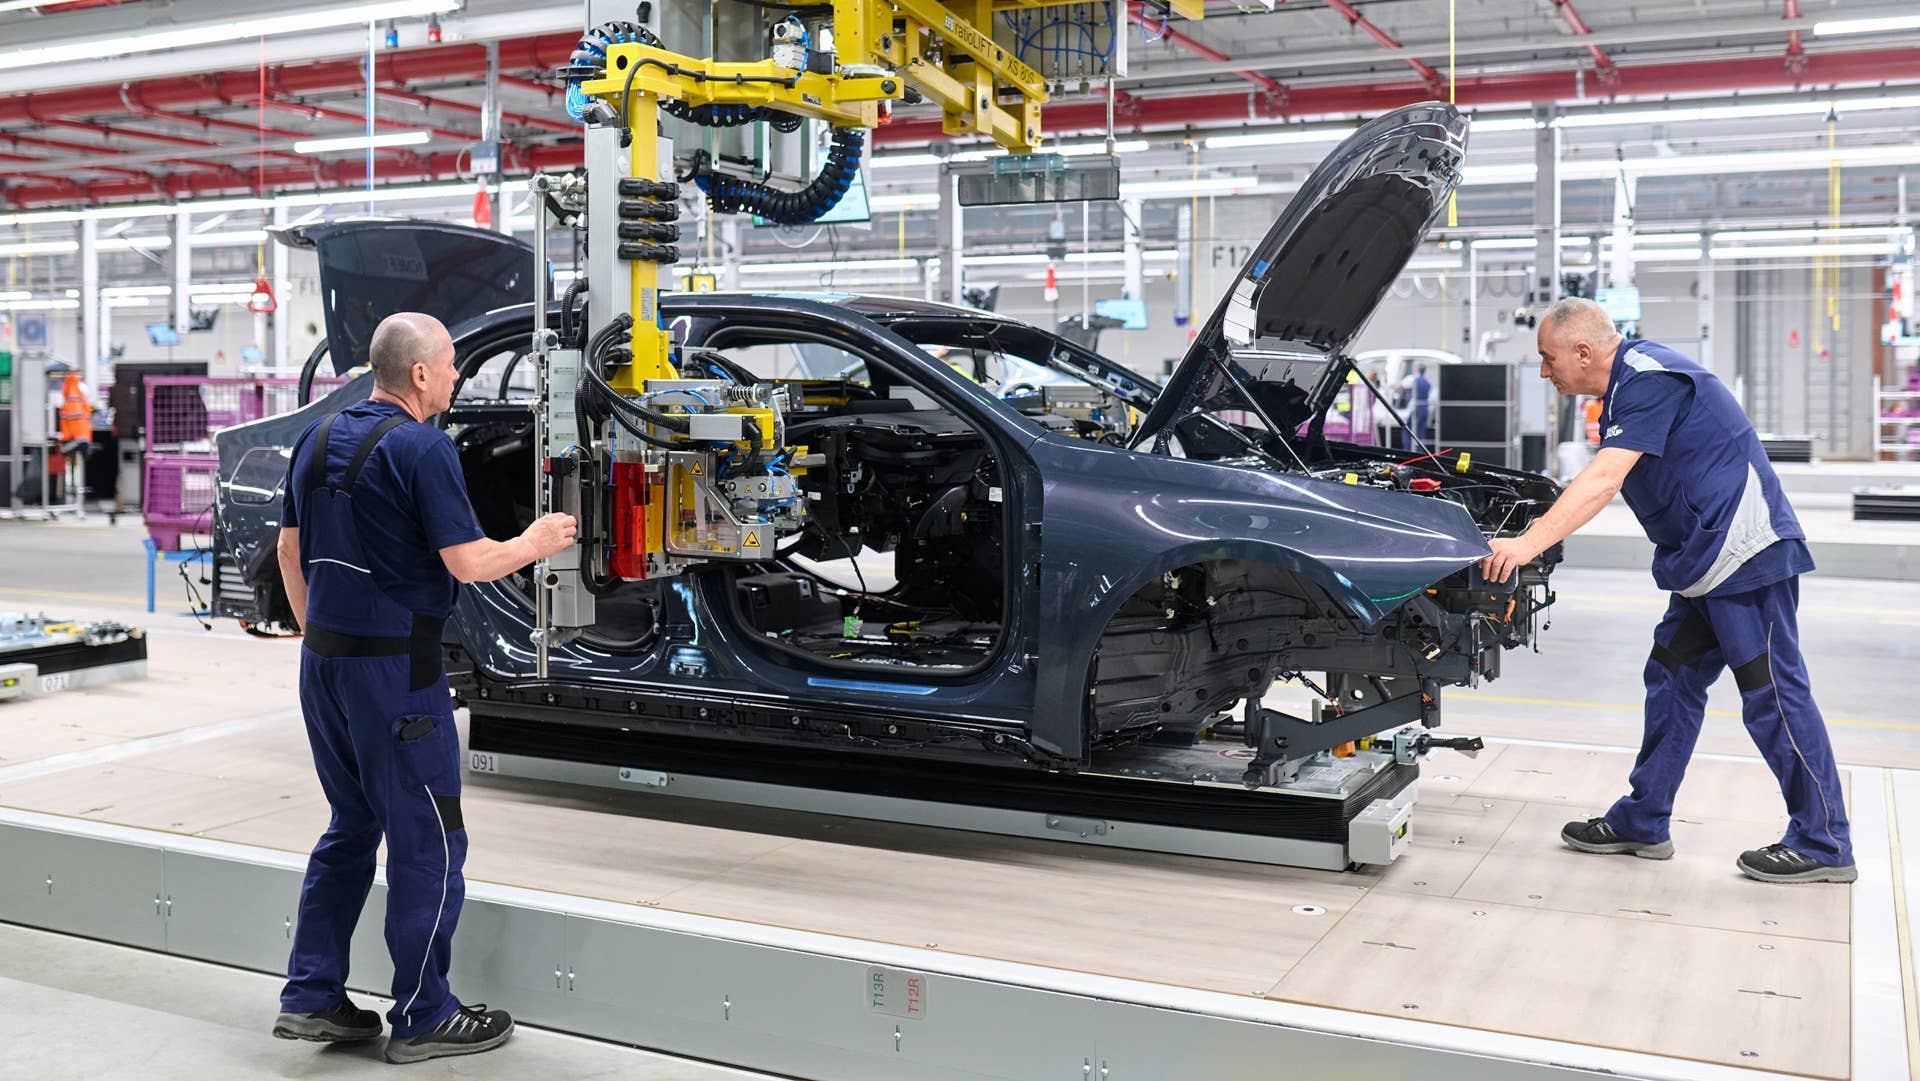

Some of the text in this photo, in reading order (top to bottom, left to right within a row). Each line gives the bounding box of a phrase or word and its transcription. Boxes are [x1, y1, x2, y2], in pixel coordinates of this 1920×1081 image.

[954, 23, 992, 57] ratioLIFT
[1007, 57, 1019, 76] XS
[472, 753, 495, 771] 091
[873, 972, 884, 1007] T13R
[908, 977, 919, 1013] T12R
